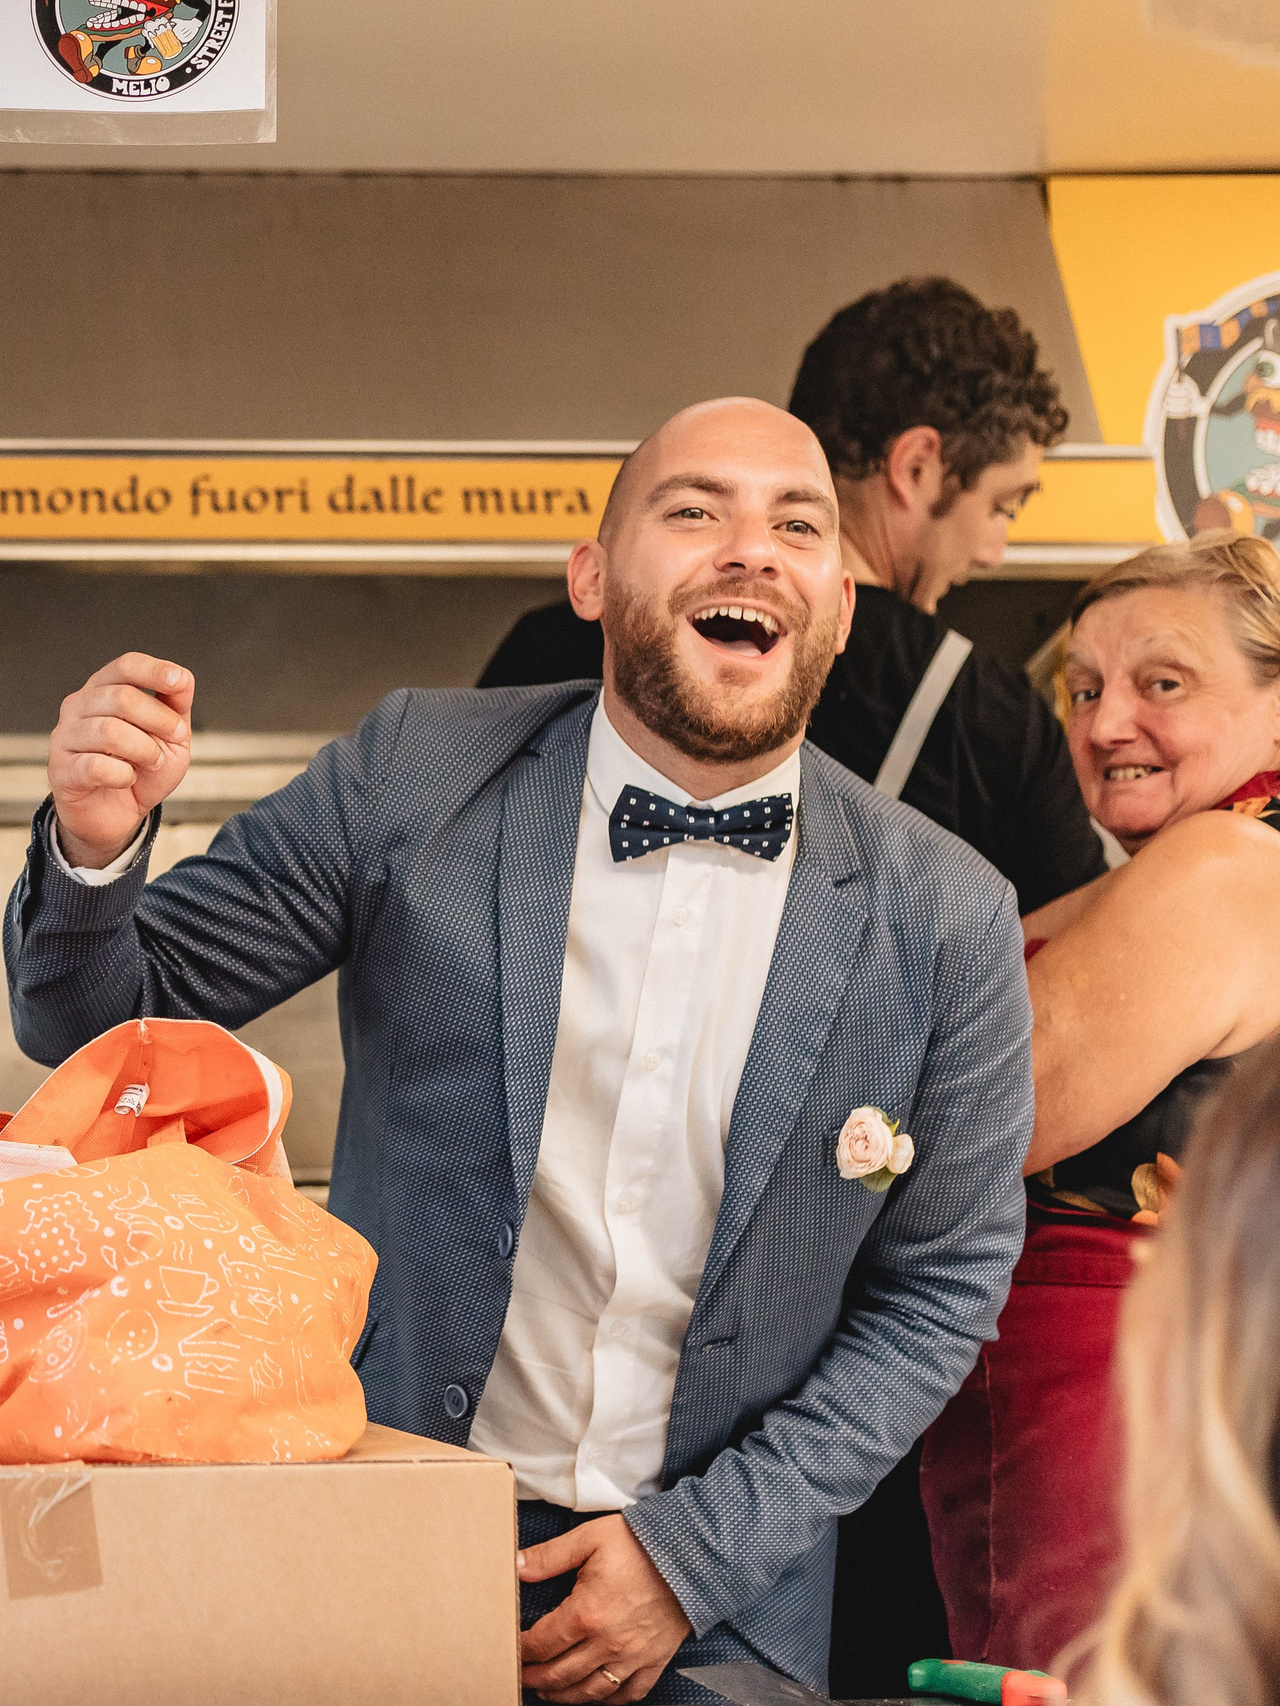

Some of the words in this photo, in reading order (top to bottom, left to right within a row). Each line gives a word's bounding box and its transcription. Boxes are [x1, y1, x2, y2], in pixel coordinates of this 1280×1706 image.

[190, 9, 233, 70] STREET
[110, 76, 171, 96] MELIO
[189, 474, 311, 516] fuori
[327, 474, 443, 514] dalle
[461, 487, 592, 515] mura
